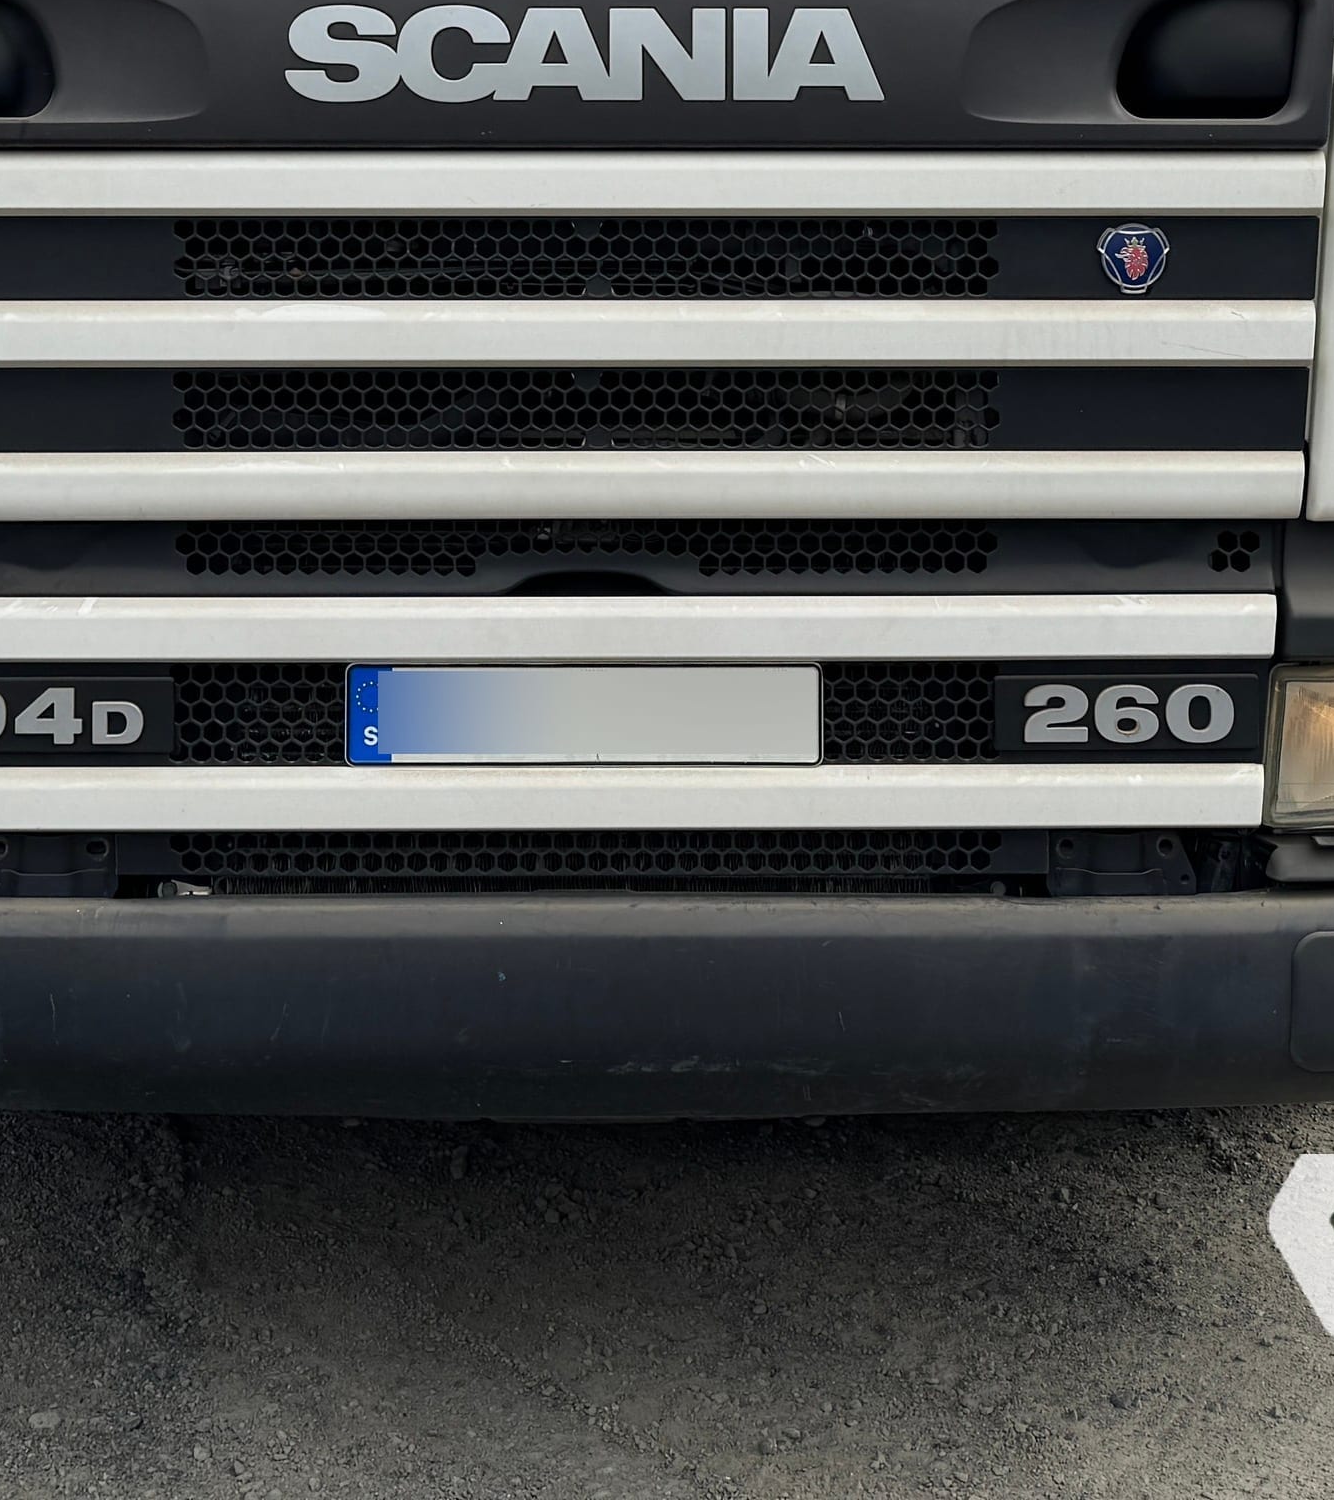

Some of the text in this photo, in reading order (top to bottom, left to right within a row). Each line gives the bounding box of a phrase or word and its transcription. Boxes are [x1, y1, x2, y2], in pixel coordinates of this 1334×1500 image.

[283, 3, 886, 103] SCANIA
[364, 725, 378, 746] S
[1023, 683, 1235, 744] 260
